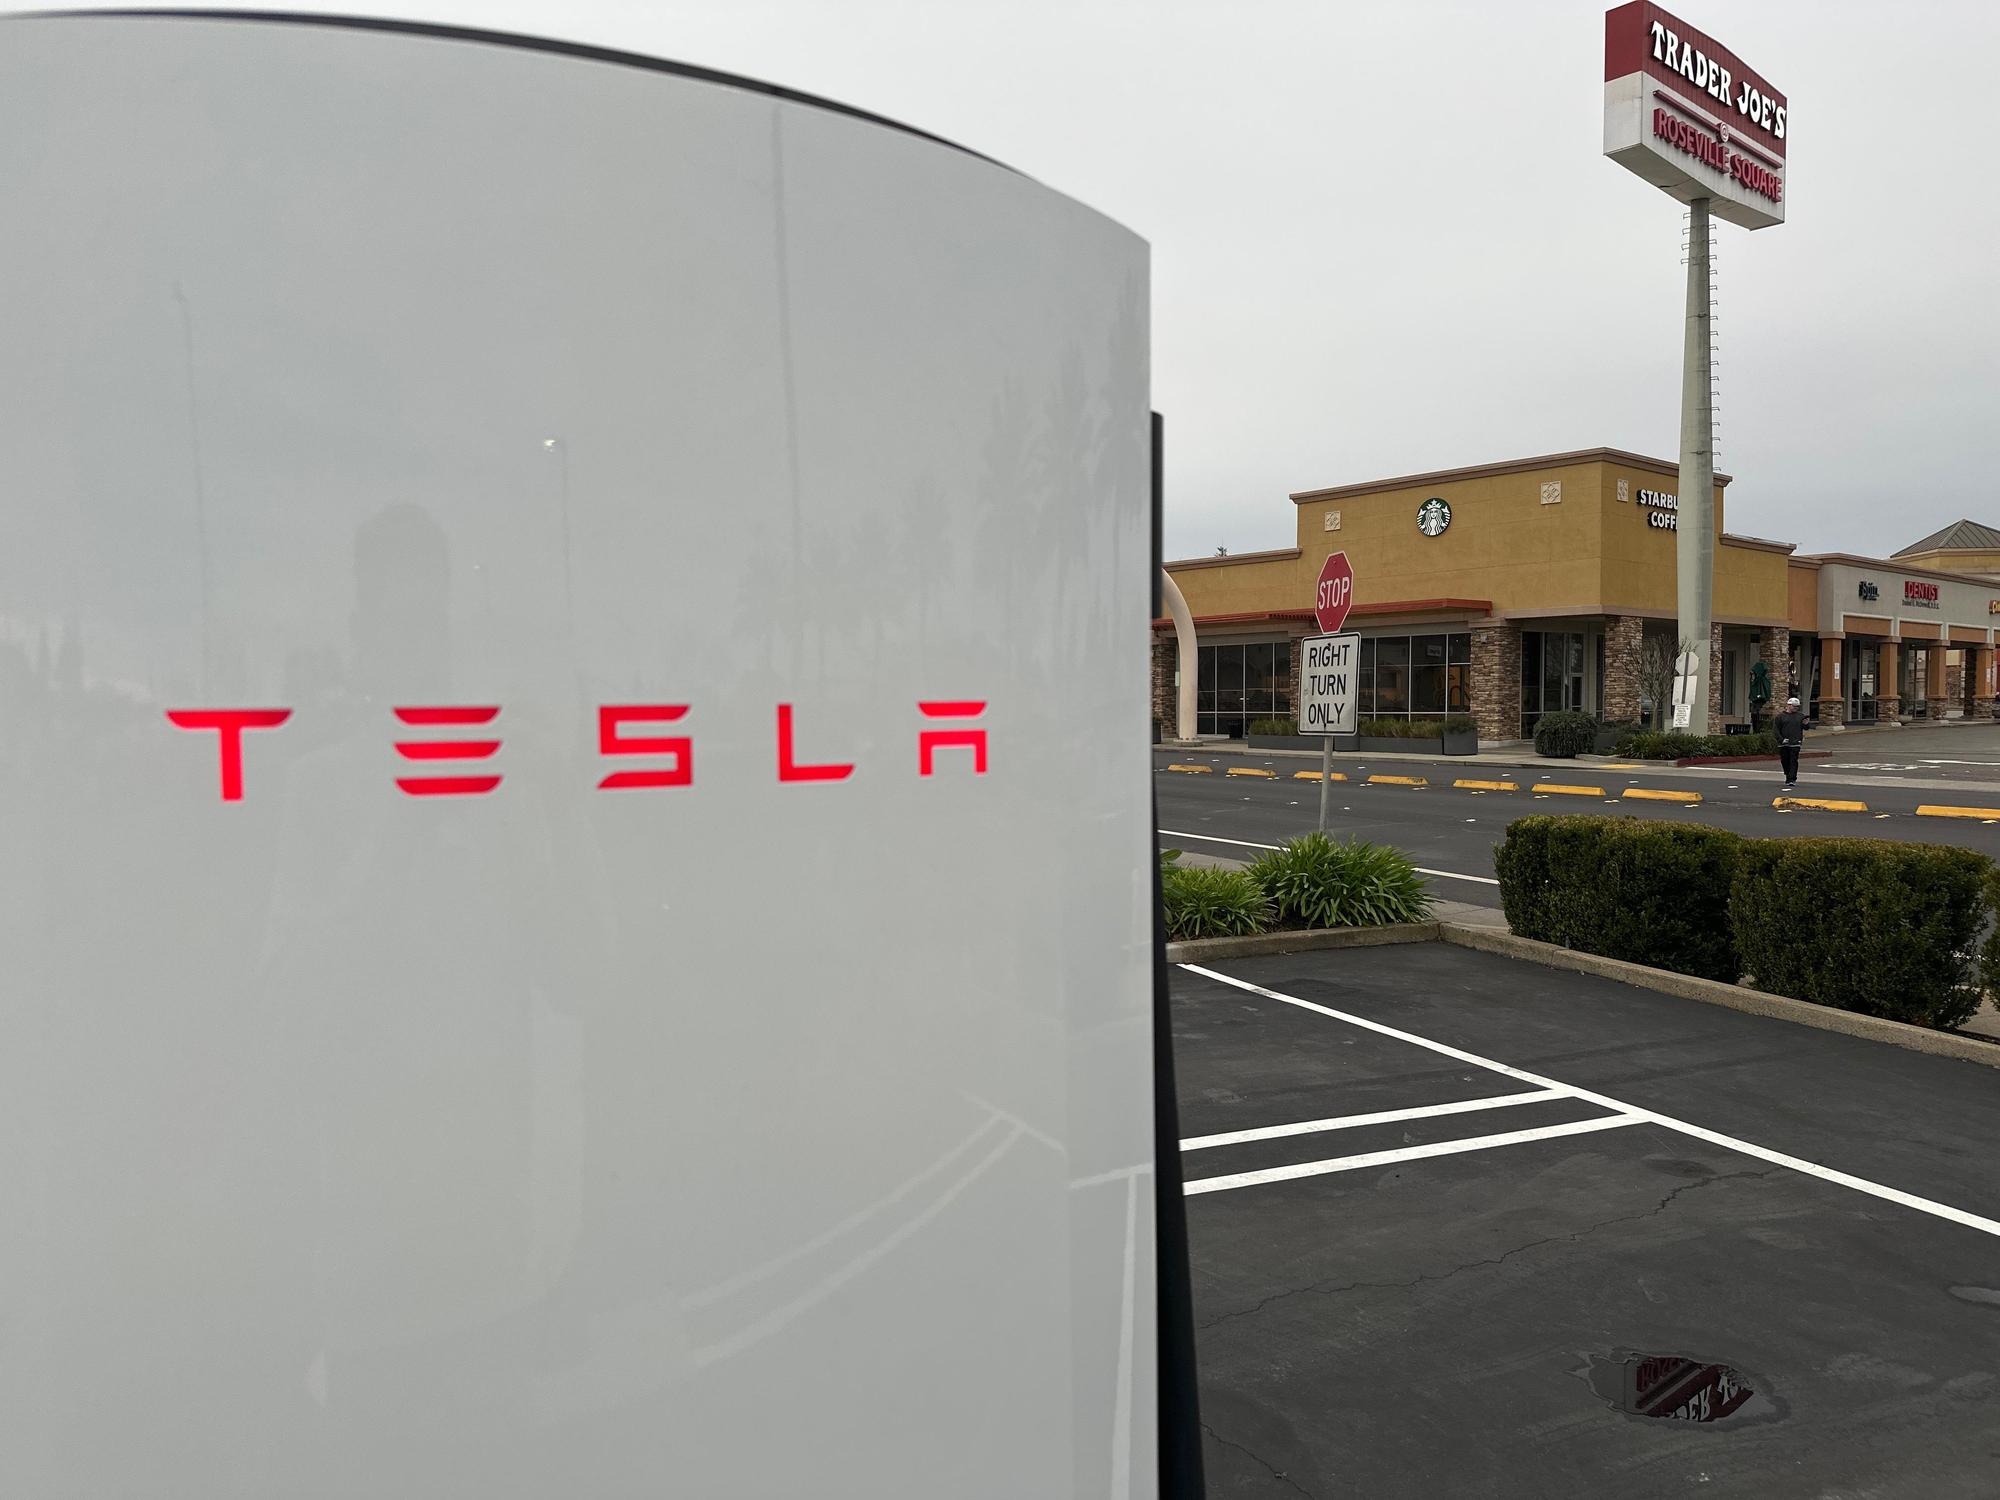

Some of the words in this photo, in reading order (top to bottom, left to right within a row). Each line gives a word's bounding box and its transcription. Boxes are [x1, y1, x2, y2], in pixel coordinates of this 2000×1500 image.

[1651, 20, 1732, 107] TRADER
[1736, 81, 1786, 139] JOE'S
[1654, 108, 1730, 174] ROSEVILLE
[1731, 153, 1782, 203] SQUARE
[1639, 488, 1679, 511] STARBU
[1649, 511, 1678, 530] COFF
[1318, 576, 1350, 610] STOP
[1308, 644, 1350, 668] RIGHT
[1310, 674, 1346, 695] TURN
[1308, 702, 1345, 725] ONLY
[164, 700, 988, 802] TESLA
